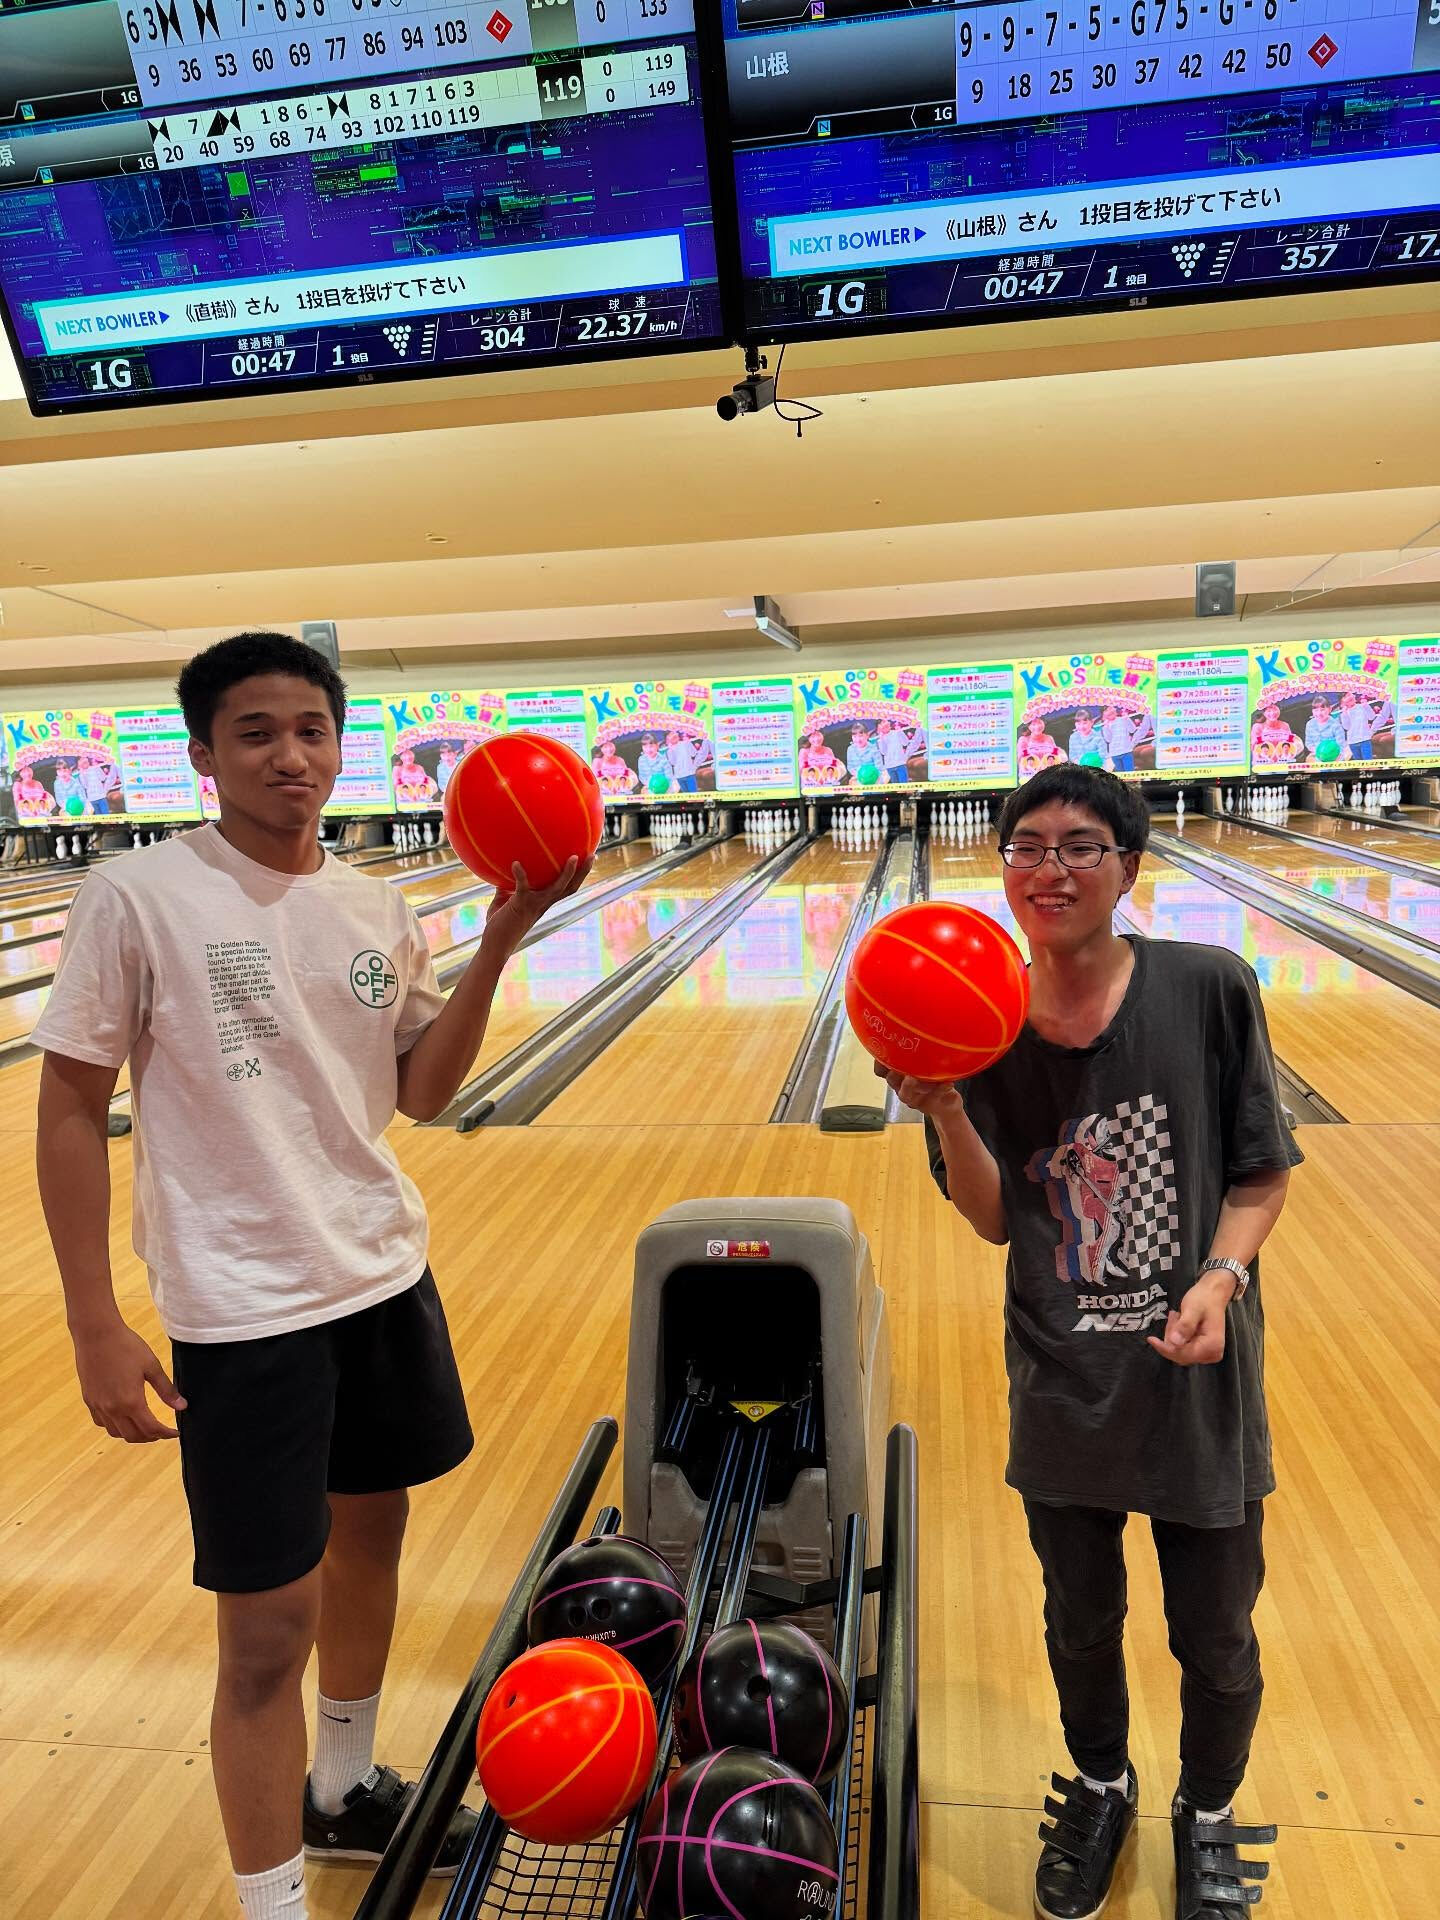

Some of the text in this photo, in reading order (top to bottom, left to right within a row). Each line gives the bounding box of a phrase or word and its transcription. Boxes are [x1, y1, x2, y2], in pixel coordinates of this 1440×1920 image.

[148, 19, 468, 87] 9 36 53 60 69 77 86 94 103
[603, 53, 673, 76] 0 119
[745, 51, 790, 80] 山根
[971, 42, 1292, 104] 9 18 25 30 37 42 42 50
[120, 90, 138, 104] 1G
[541, 76, 582, 102] 119
[606, 80, 676, 103] 0 149
[934, 107, 953, 121] 1G
[163, 105, 480, 163] 20 40 59 68 74 93 102 110 119
[138, 157, 155, 170] 1G
[789, 227, 911, 257] NEXT BOWLER
[1276, 223, 1351, 244] レーン合計
[997, 254, 1055, 272] 経過時間
[1280, 243, 1339, 272] 357
[814, 281, 866, 317] 1G
[984, 271, 1063, 301] 00:47
[55, 311, 158, 337] NEXT BOWLER
[470, 309, 532, 326] レーン合計
[578, 313, 678, 340] 22.37 km/h
[238, 334, 286, 350] 経過時間
[480, 326, 525, 351] 304
[91, 359, 132, 391] 1G
[231, 350, 296, 376] 00:47
[1255, 650, 1325, 684] KIDS
[1019, 664, 1086, 699] KIDS
[589, 690, 649, 723] KIDS
[798, 679, 861, 712] KIDS
[388, 701, 446, 732] KIDS
[1076, 1283, 1168, 1310] HONDA
